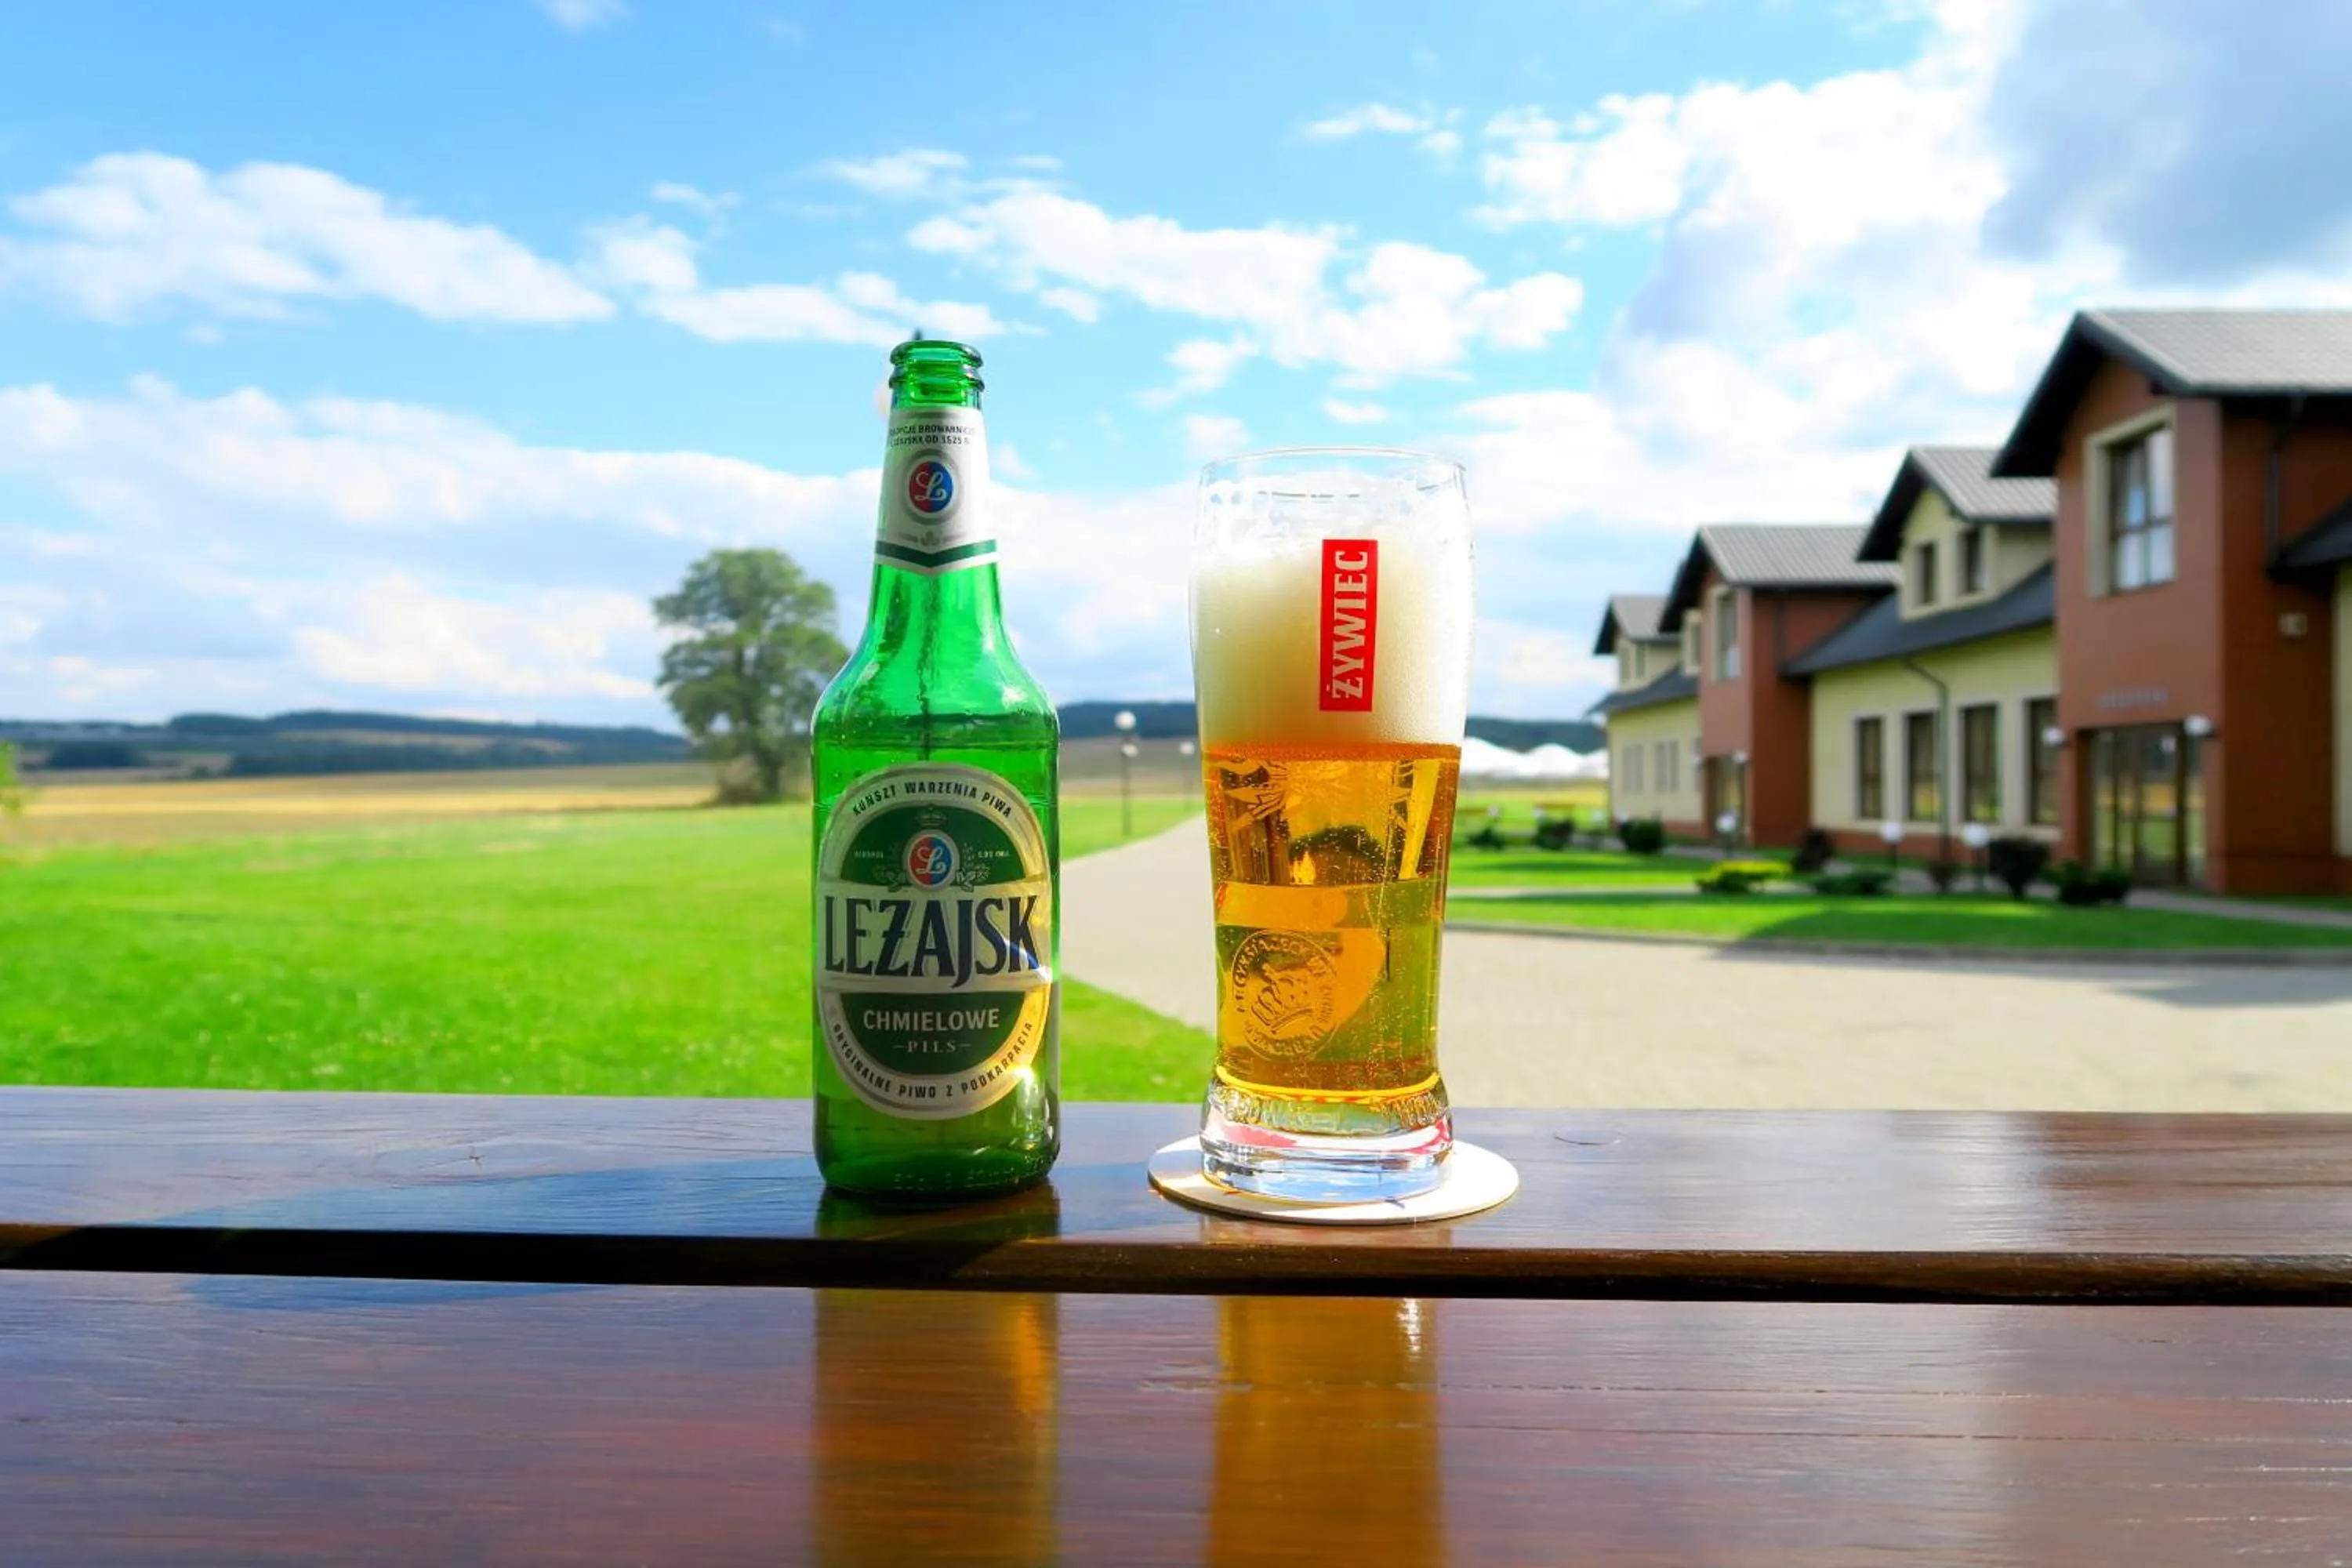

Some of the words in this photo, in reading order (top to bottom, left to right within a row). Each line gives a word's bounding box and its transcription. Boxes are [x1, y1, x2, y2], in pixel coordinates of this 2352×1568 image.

[1326, 550, 1368, 699] ŻYWIEC
[853, 785, 896, 816] KUNSZT
[904, 781, 978, 799] WARZENIA
[982, 791, 1012, 818] PIWA
[863, 1008, 1000, 1033] CHMIELOWE
[833, 1022, 891, 1093] ORYGINALNE
[898, 1083, 936, 1098] PIWO
[946, 1083, 953, 1097] Z
[960, 1022, 1033, 1094] PODKARPACIA
